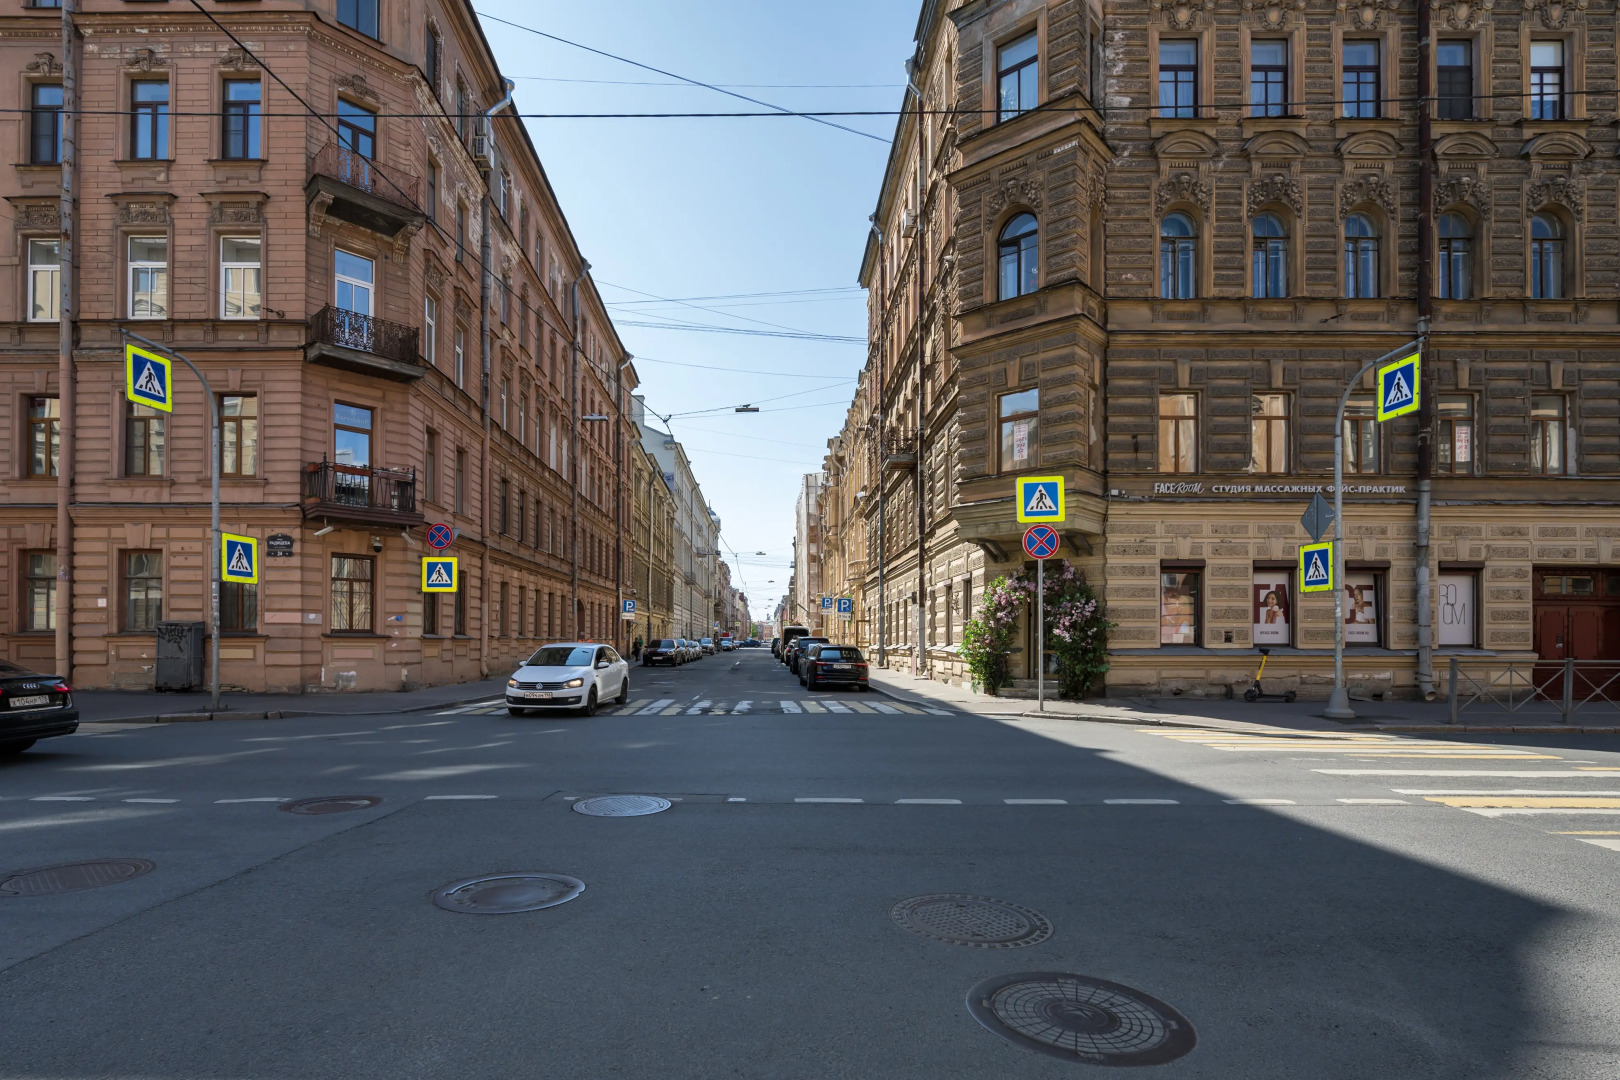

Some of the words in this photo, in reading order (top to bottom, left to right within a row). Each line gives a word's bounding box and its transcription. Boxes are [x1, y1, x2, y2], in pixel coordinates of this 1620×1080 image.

[1212, 485, 1252, 494] СТУДИЯ
[1254, 485, 1323, 493] МАССАЖНЫХ
[1326, 484, 1406, 493] ФЙС-ПРАКТИК
